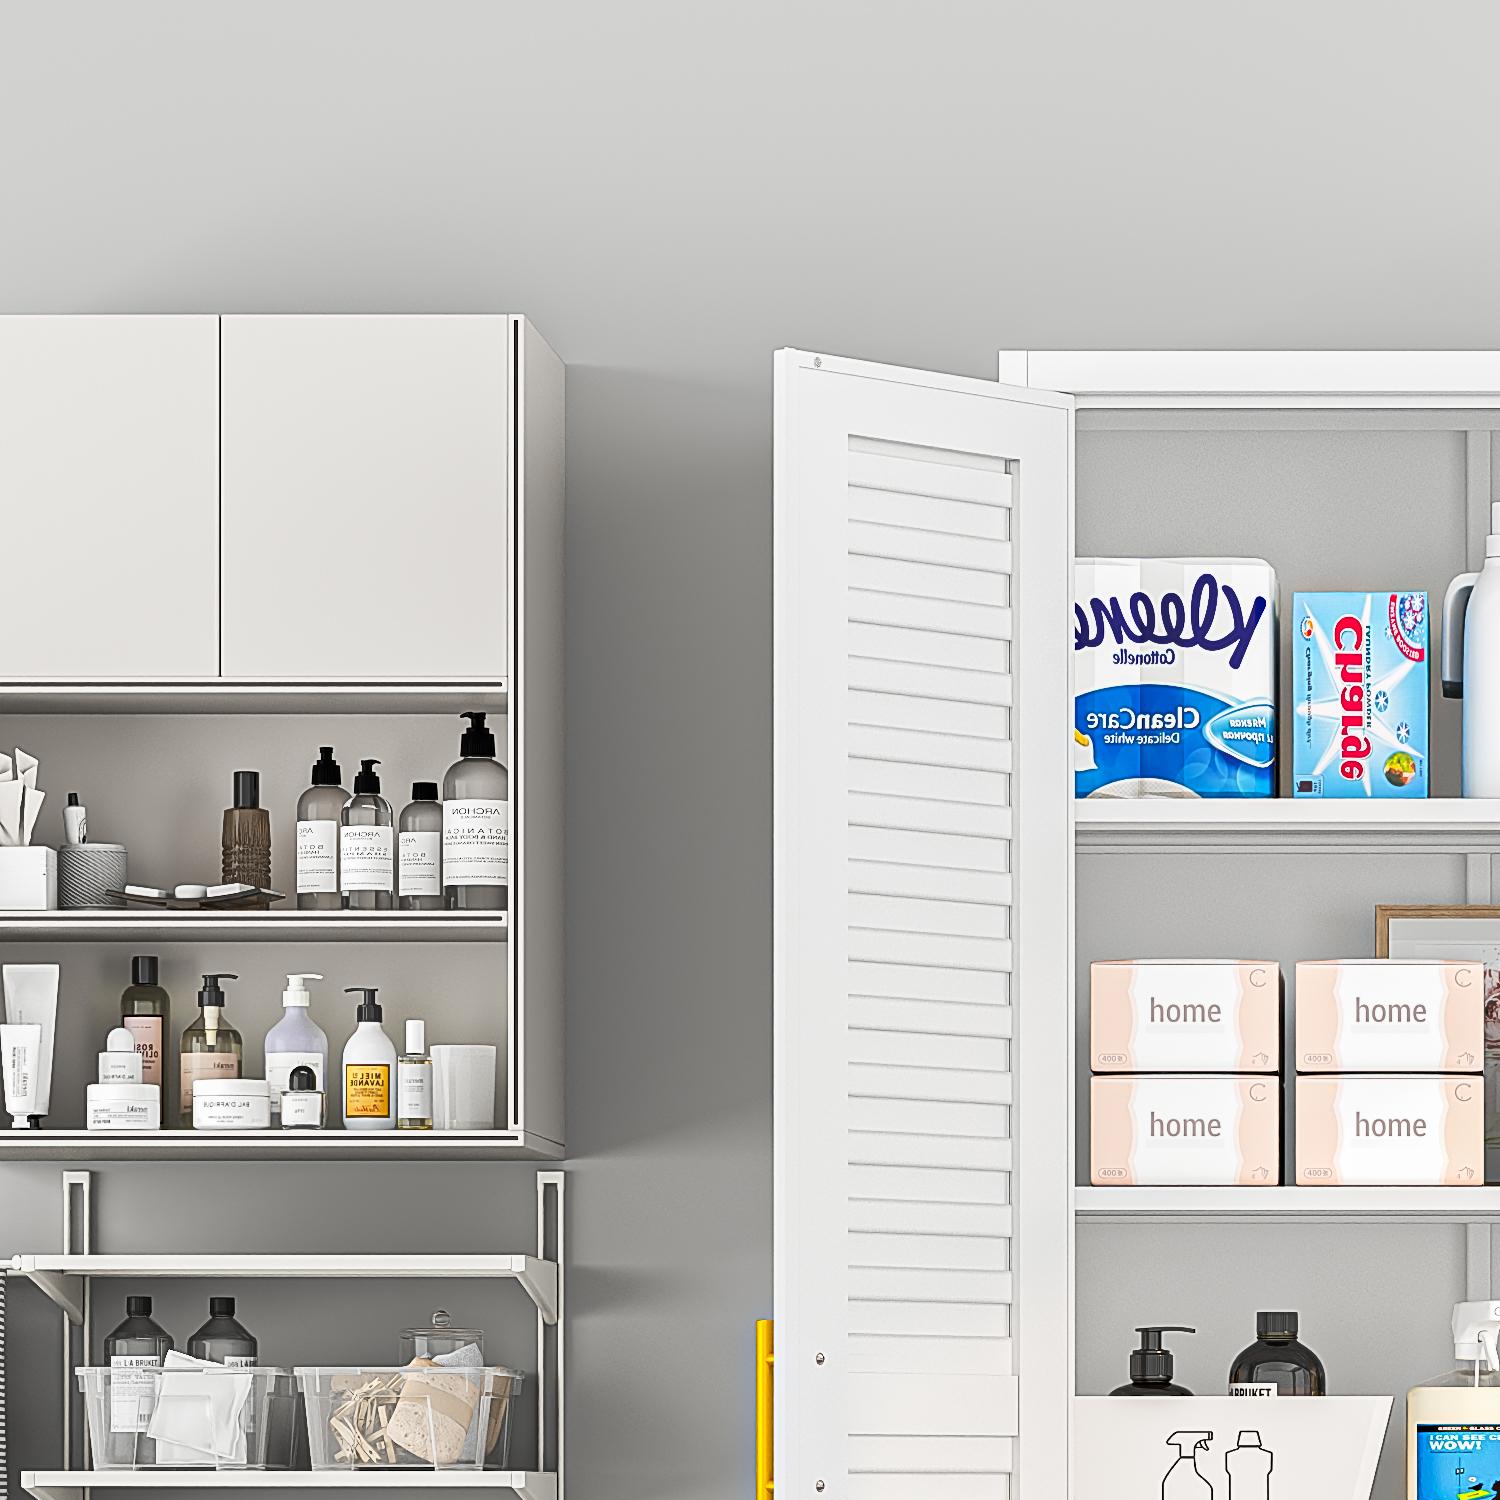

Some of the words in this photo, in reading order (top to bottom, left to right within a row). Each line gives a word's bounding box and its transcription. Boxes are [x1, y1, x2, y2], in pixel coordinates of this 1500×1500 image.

[1150, 997, 1221, 1022] home
[1356, 997, 1426, 1022] home
[1150, 1112, 1221, 1136] home
[1356, 1112, 1426, 1136] home
[1429, 1441, 1482, 1450] WOW!
